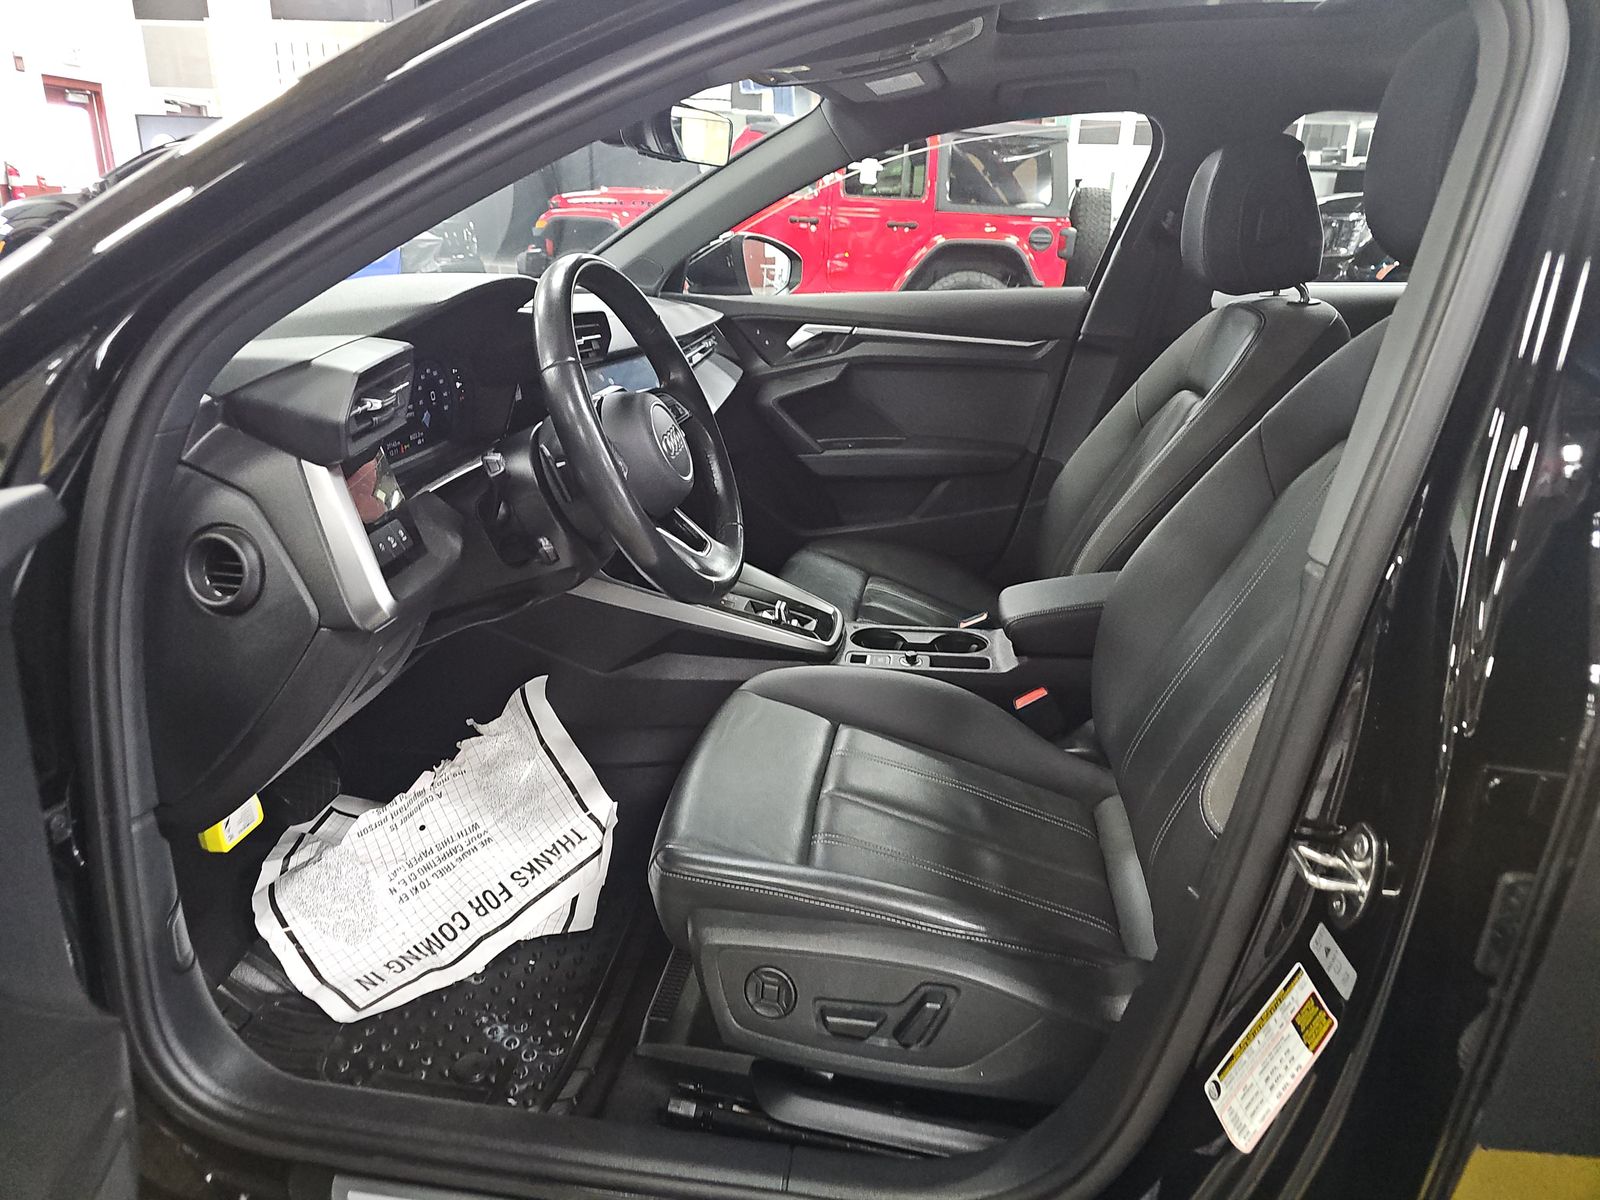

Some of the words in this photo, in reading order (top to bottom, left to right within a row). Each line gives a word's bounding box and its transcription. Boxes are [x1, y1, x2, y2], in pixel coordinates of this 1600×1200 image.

[390, 787, 426, 820] important
[435, 791, 442, 799] A
[357, 816, 388, 837] person
[457, 822, 480, 839] WITH
[435, 835, 454, 852] THIS
[478, 837, 493, 848] WE
[406, 847, 434, 868] PAPER
[417, 844, 463, 876] CARPETING
[456, 846, 478, 863] HAVE
[510, 828, 587, 889] THANKS
[389, 872, 417, 895] CLEN
[419, 878, 431, 890] TO
[467, 881, 513, 917] FOR
[383, 911, 470, 973] COMING
[354, 971, 385, 991] IN
